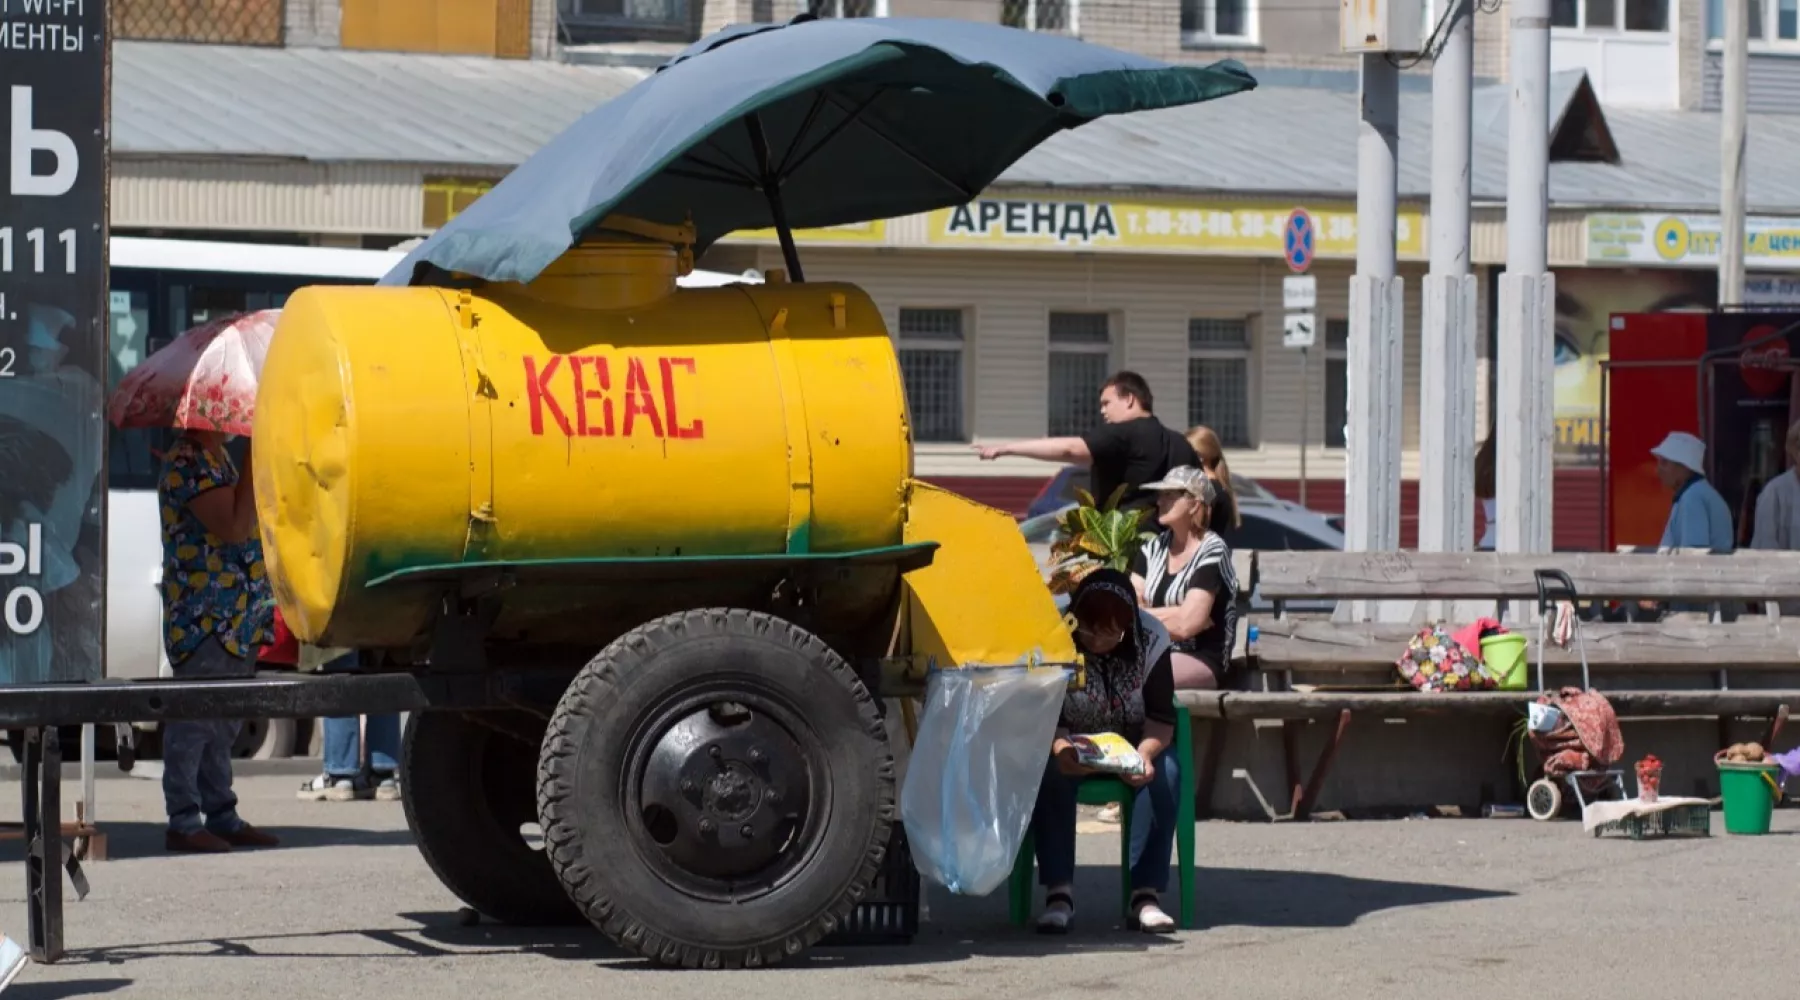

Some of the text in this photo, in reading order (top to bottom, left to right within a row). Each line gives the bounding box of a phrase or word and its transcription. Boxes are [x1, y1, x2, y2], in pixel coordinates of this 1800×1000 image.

[10, 85, 79, 196] Ь
[949, 200, 1116, 241] АРЕНДА
[523, 355, 704, 439] КВАС
